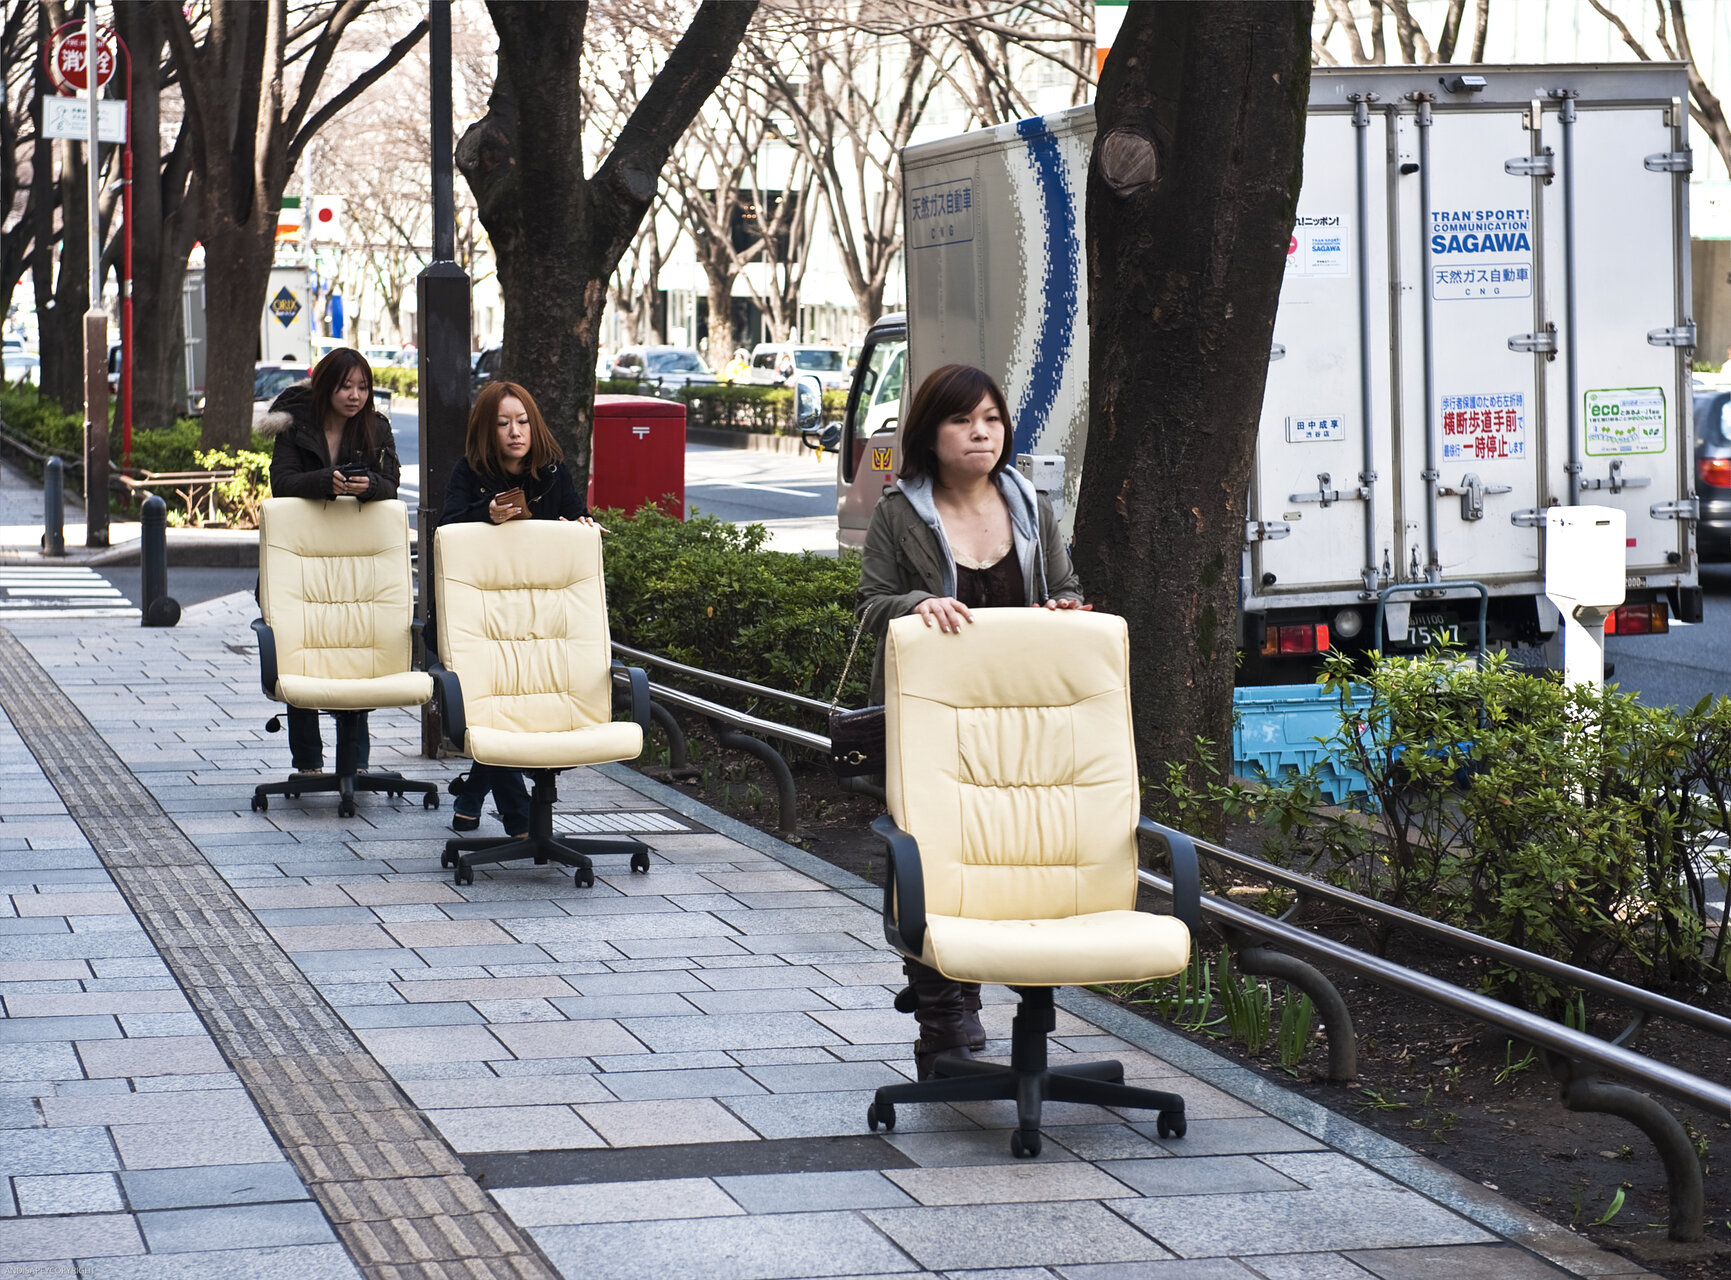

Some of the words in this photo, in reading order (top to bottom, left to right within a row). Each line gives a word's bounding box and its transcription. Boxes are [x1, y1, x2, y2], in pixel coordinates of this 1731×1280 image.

[912, 187, 971, 220] 天然ガス自動車
[1433, 222, 1527, 232] COMMUNICATION
[1431, 233, 1531, 254] SAGAWA
[1436, 267, 1529, 284] 天然ガス自動車
[1443, 408, 1523, 435] 横断歩道手前で
